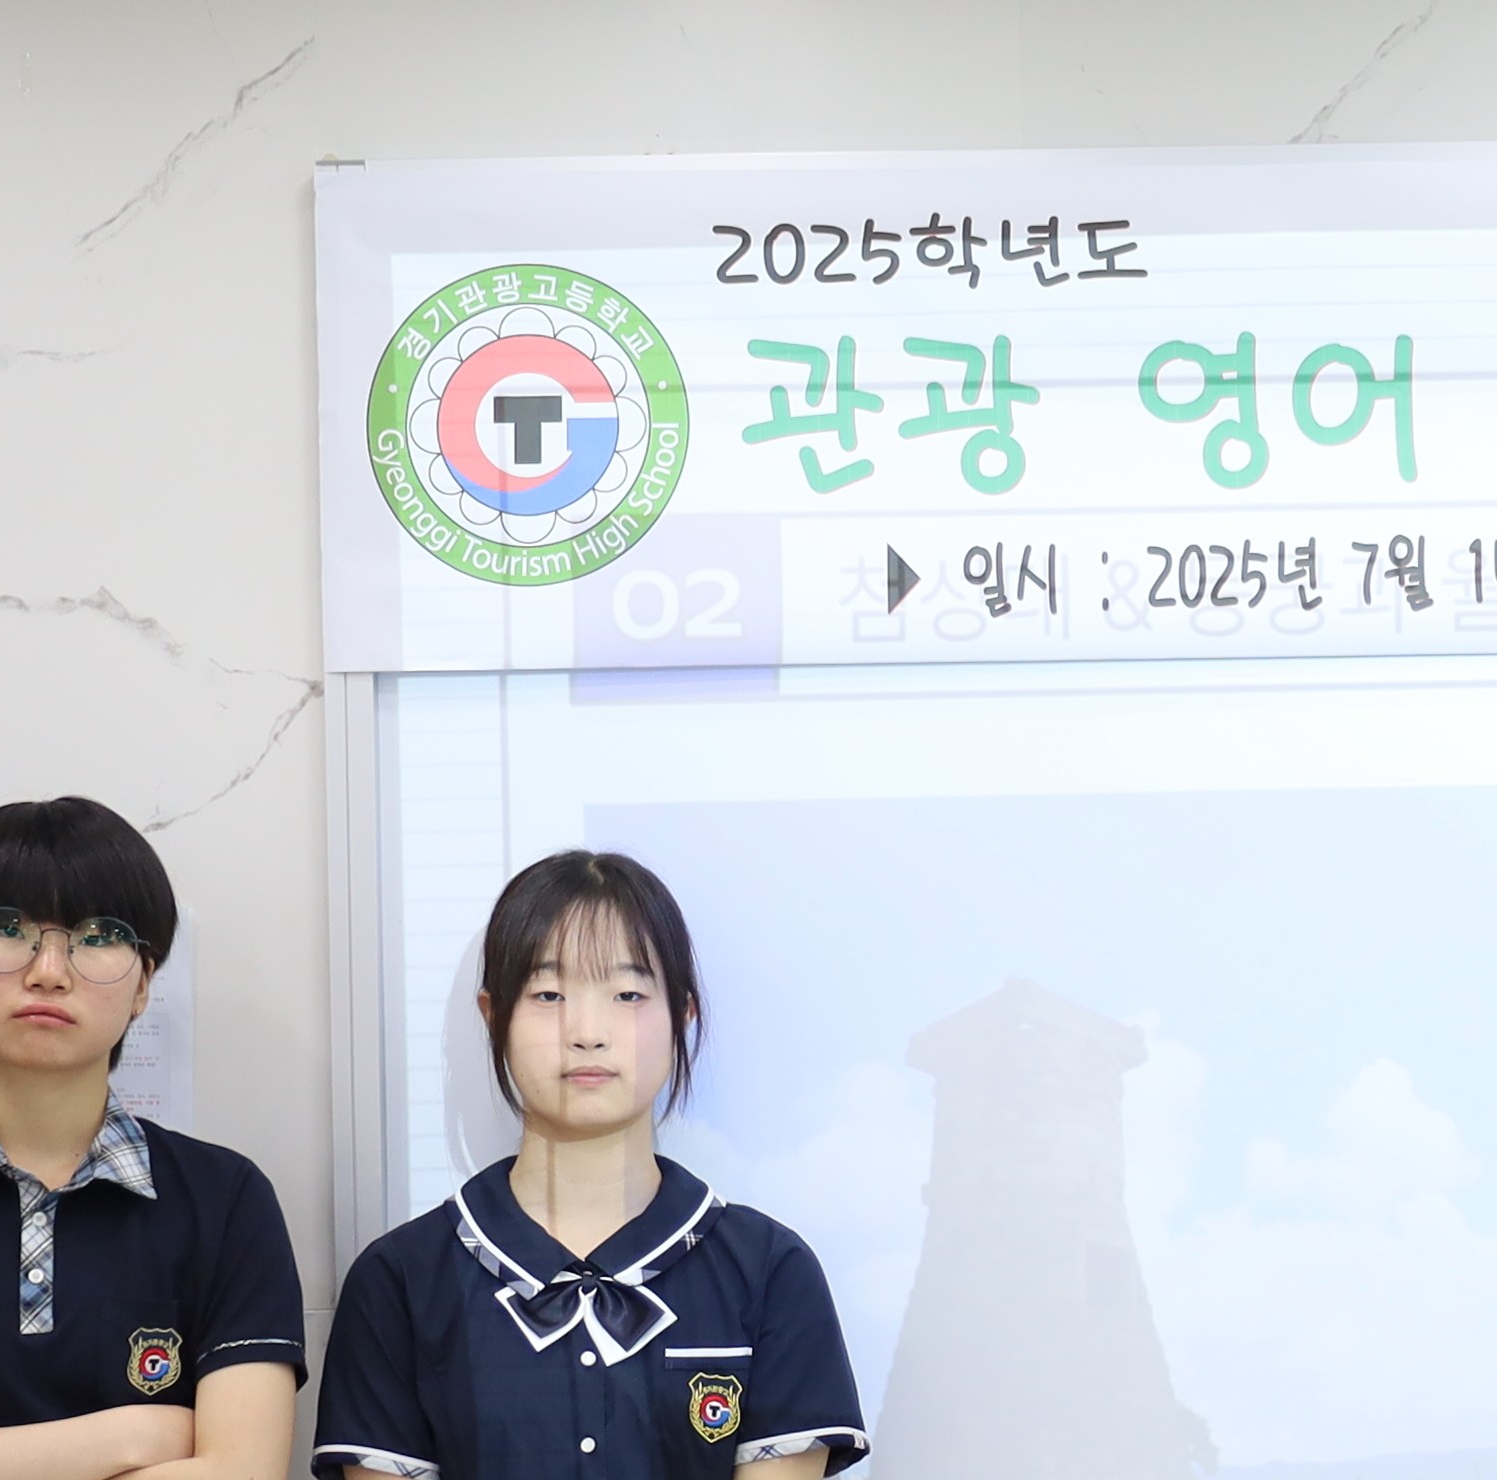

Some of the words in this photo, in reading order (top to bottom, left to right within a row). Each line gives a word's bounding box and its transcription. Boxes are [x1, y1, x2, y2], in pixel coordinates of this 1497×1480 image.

[711, 211, 1148, 289] 2025학년도
[397, 272, 655, 360] 경기관광고등학교
[742, 334, 1039, 494] 관광
[1138, 330, 1416, 488] 영어
[373, 429, 462, 552] Gyeonggi
[461, 534, 572, 577] Tourism
[572, 512, 638, 565] High
[628, 422, 680, 517] School
[610, 568, 743, 643] 02
[963, 541, 1057, 618] 일시
[1146, 537, 1324, 611] 2025년
[1351, 534, 1435, 611] 7월
[1102, 558, 1155, 633] &
